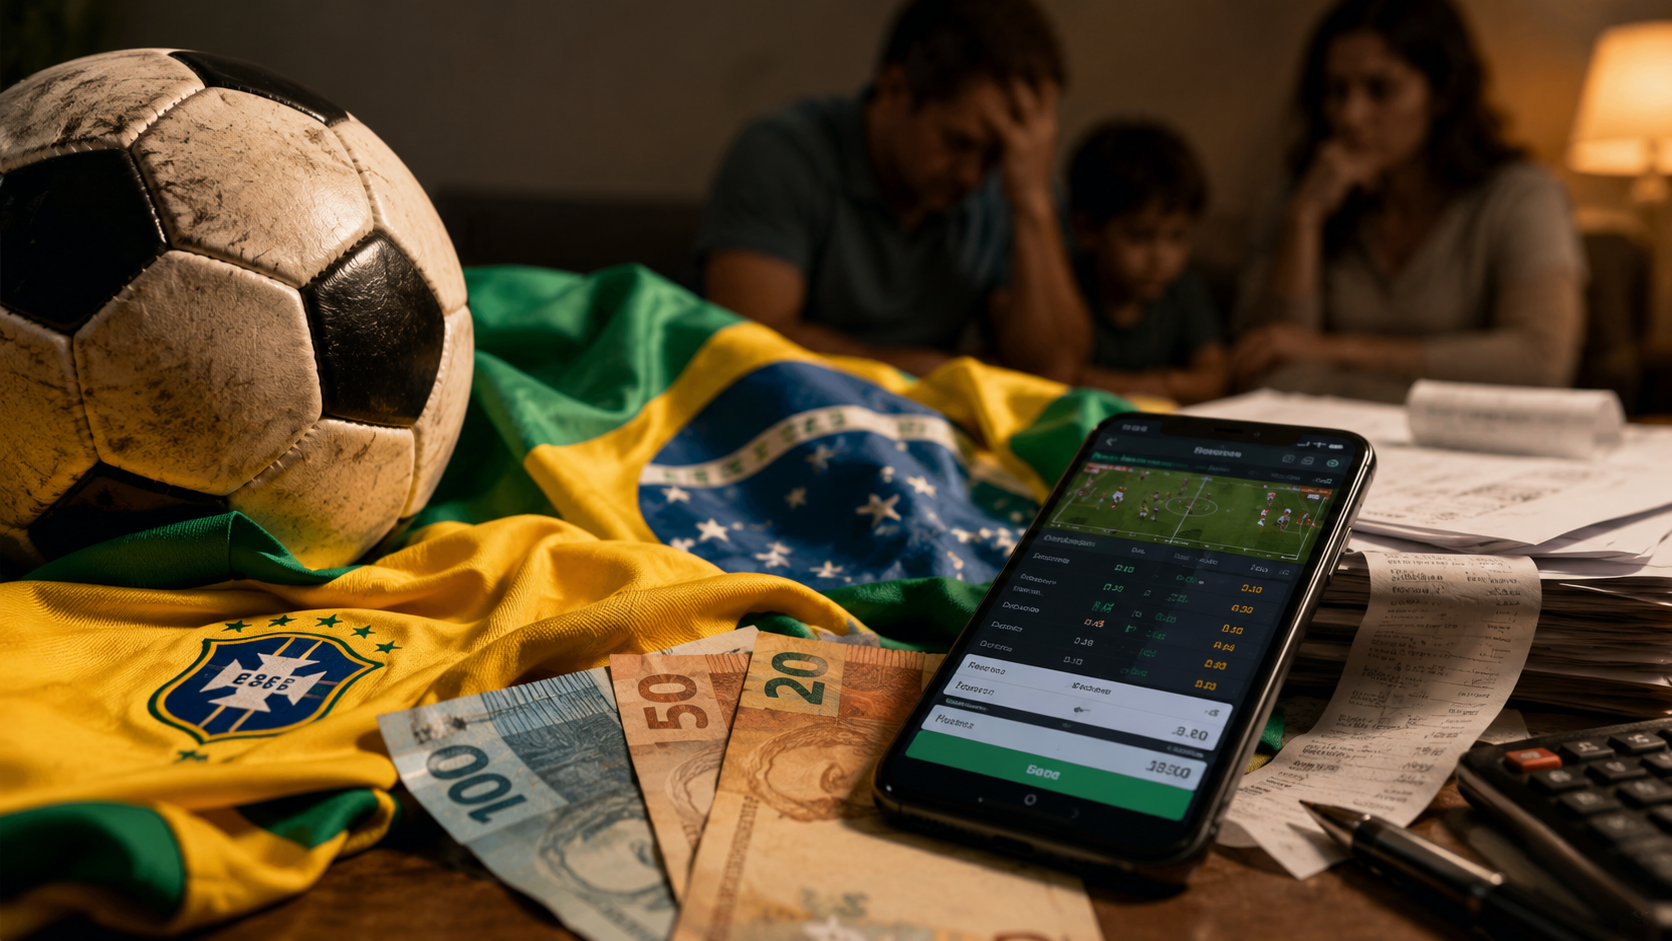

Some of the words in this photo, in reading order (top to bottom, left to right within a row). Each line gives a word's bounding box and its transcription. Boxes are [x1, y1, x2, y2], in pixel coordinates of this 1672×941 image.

[637, 672, 709, 731] 50
[763, 650, 829, 706] 20
[425, 743, 529, 825] 100
